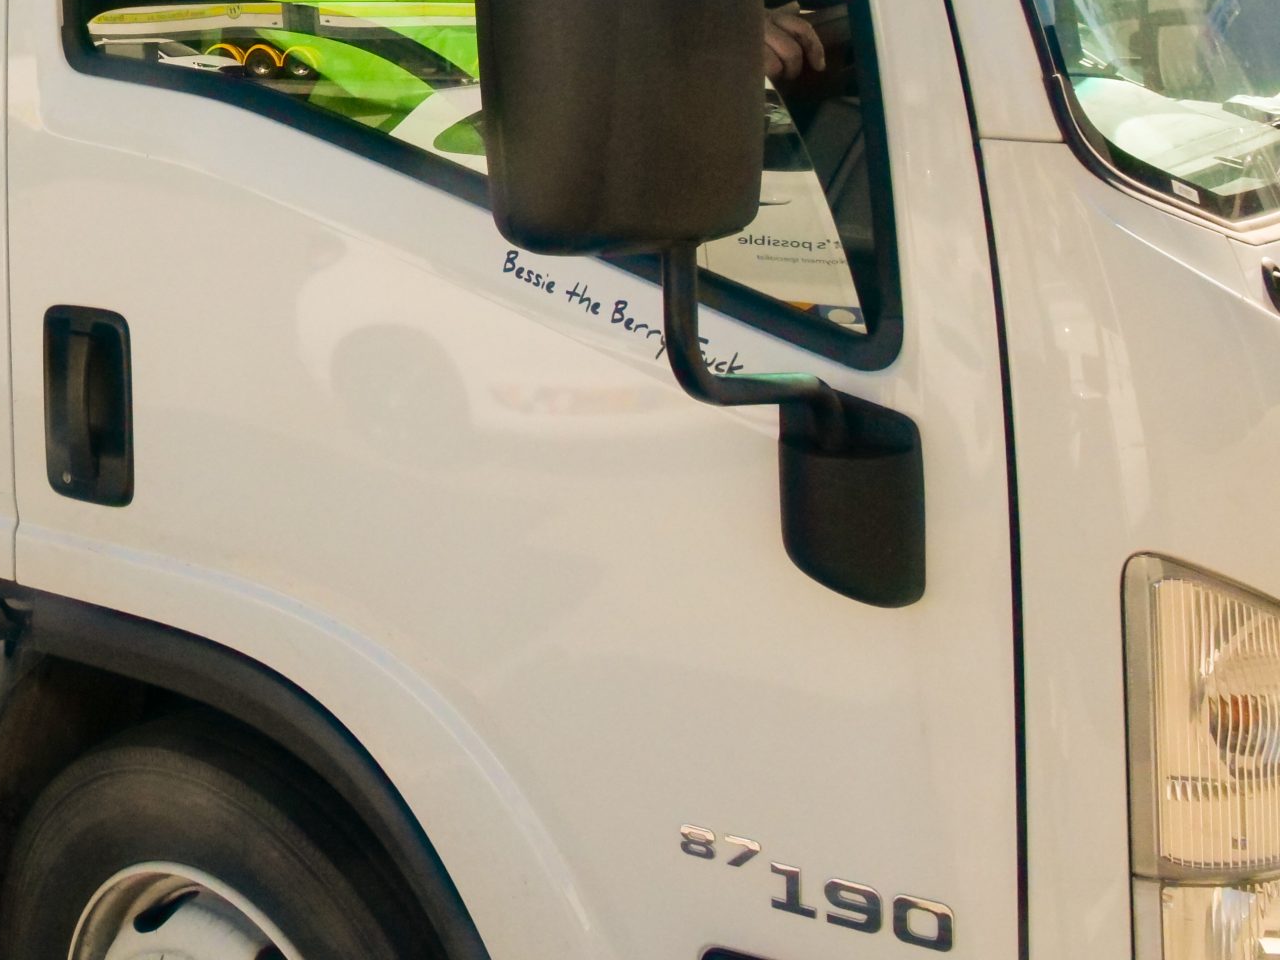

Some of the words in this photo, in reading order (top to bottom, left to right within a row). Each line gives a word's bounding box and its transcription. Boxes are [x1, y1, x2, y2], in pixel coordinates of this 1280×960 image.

[502, 250, 556, 294] Bessie
[565, 281, 601, 315] the
[680, 823, 761, 867] 87
[770, 860, 954, 952] 190
